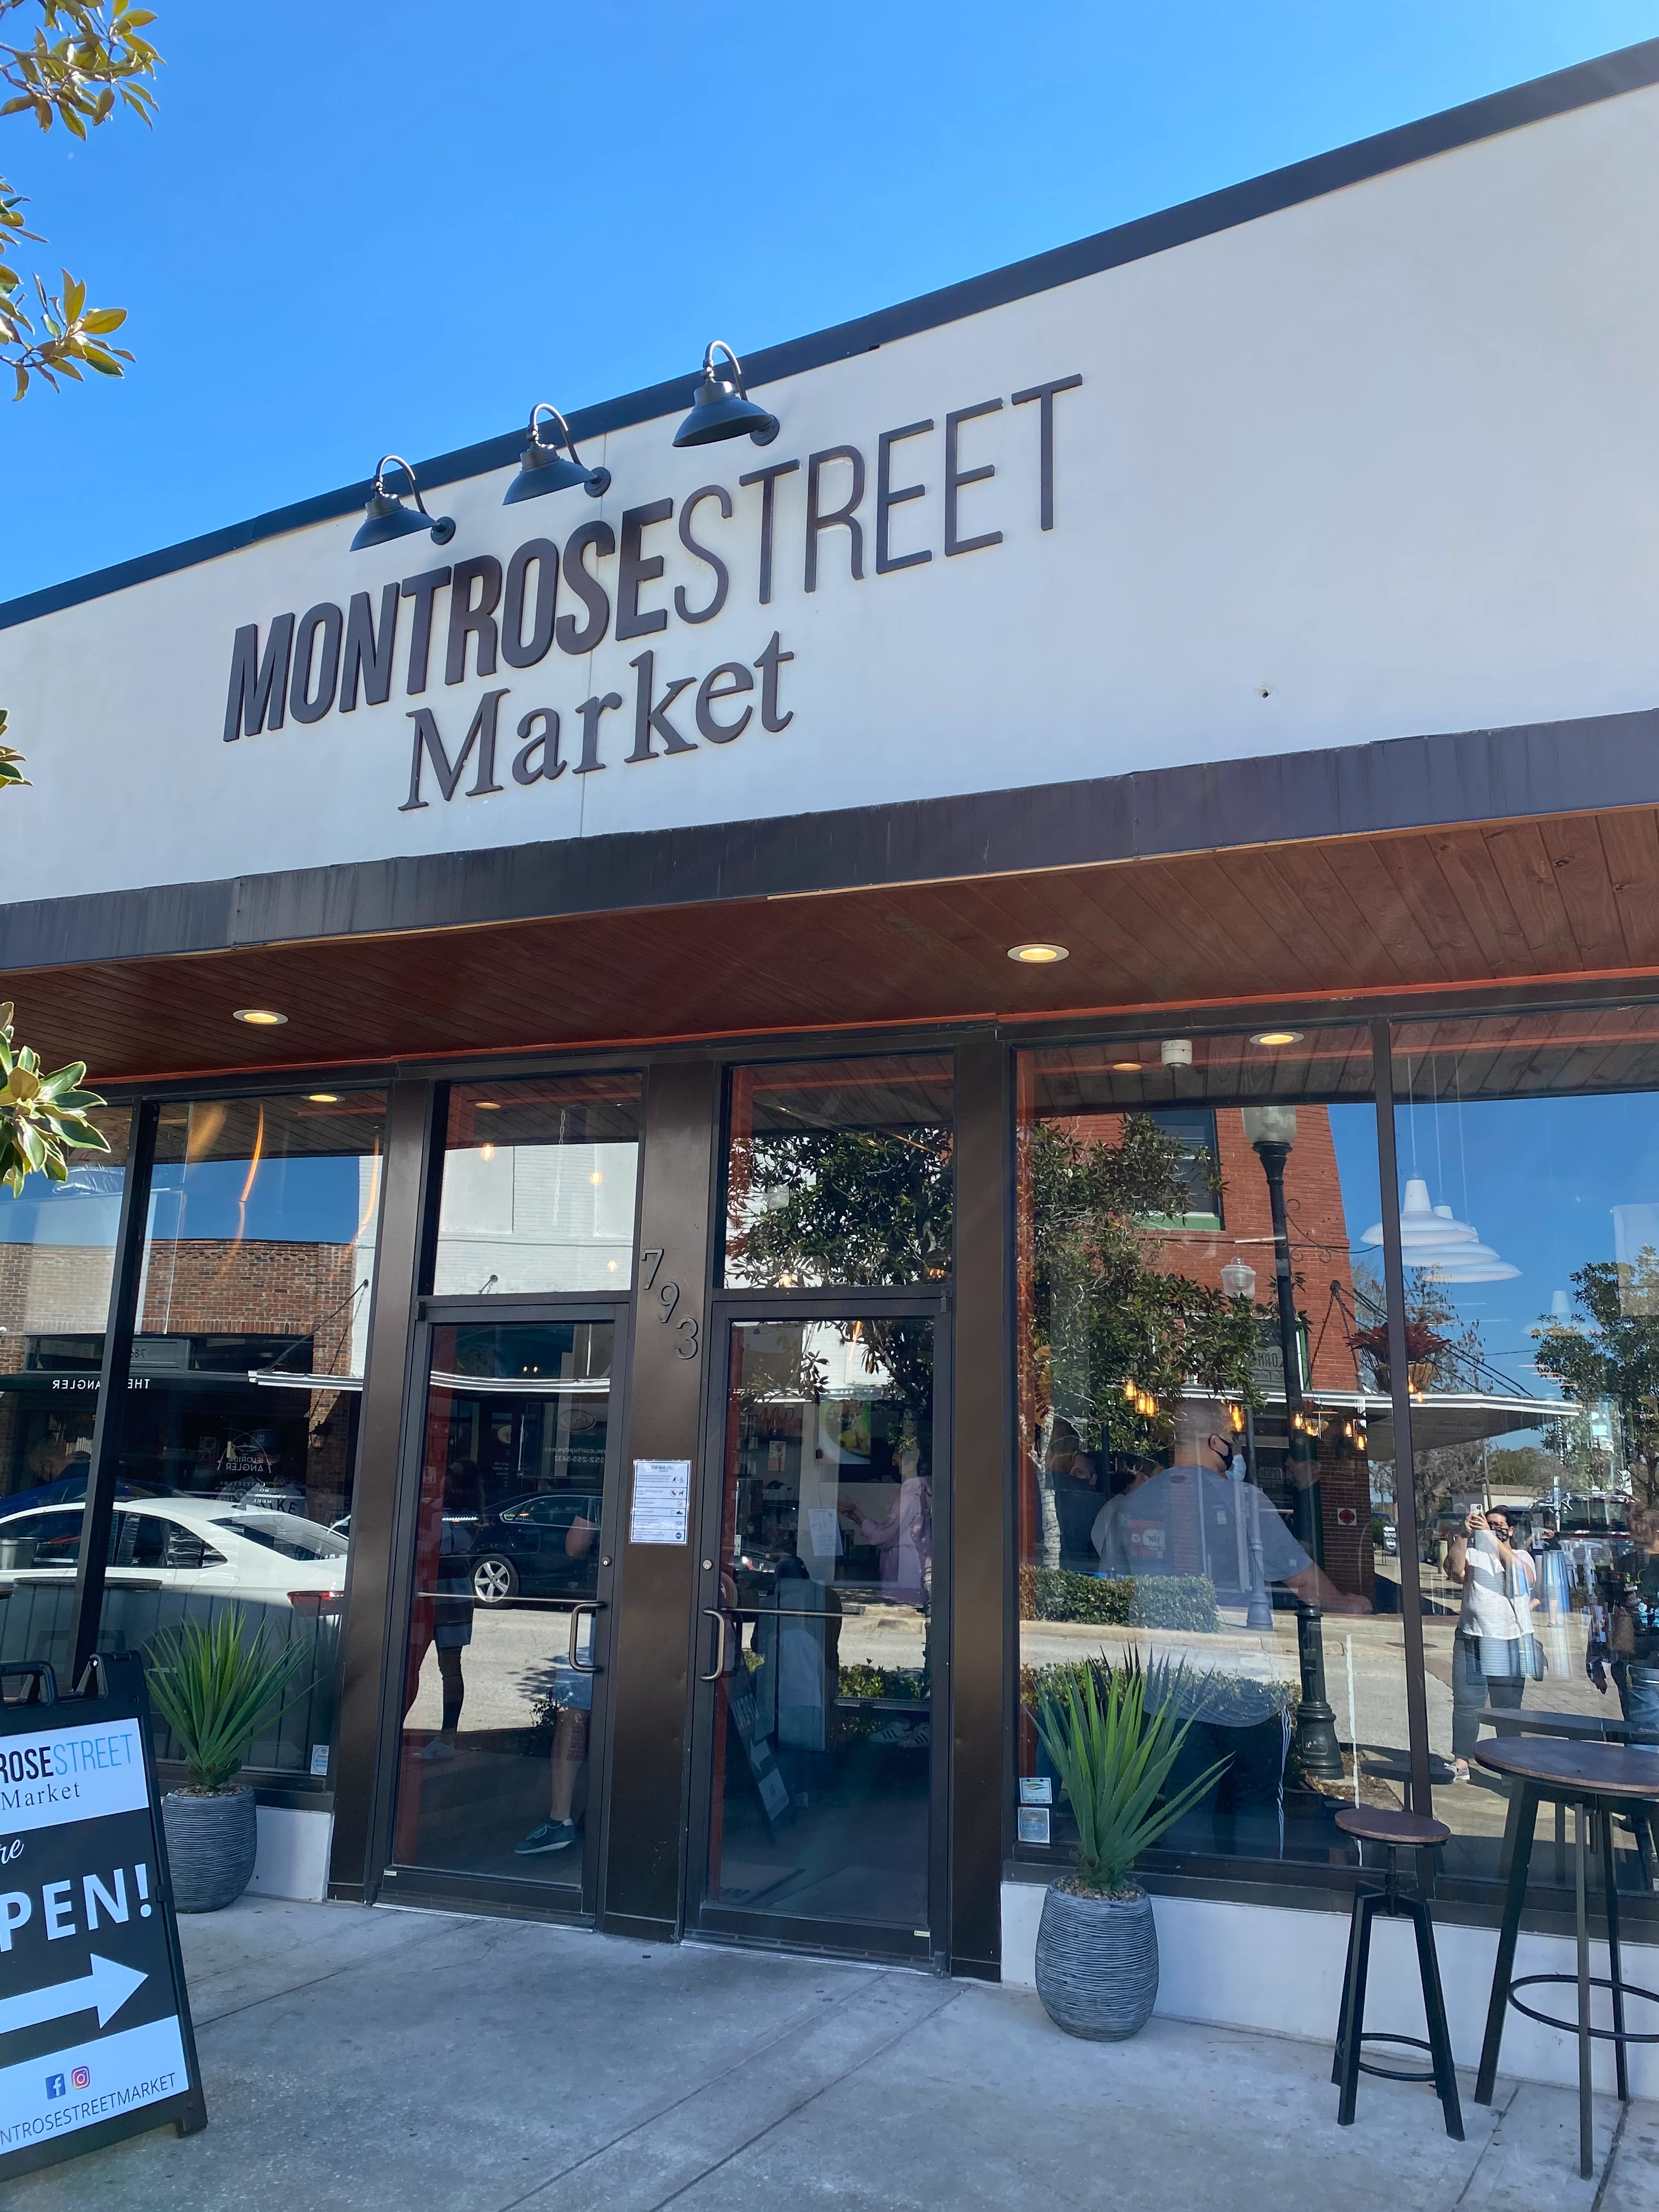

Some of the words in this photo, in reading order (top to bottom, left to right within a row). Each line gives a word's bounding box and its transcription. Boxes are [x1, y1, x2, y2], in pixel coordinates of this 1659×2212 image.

[223, 373, 1082, 742] MONTROSESTREET
[398, 631, 795, 811] Market
[641, 1248, 698, 1359] 793
[1, 1782, 81, 1810] Market
